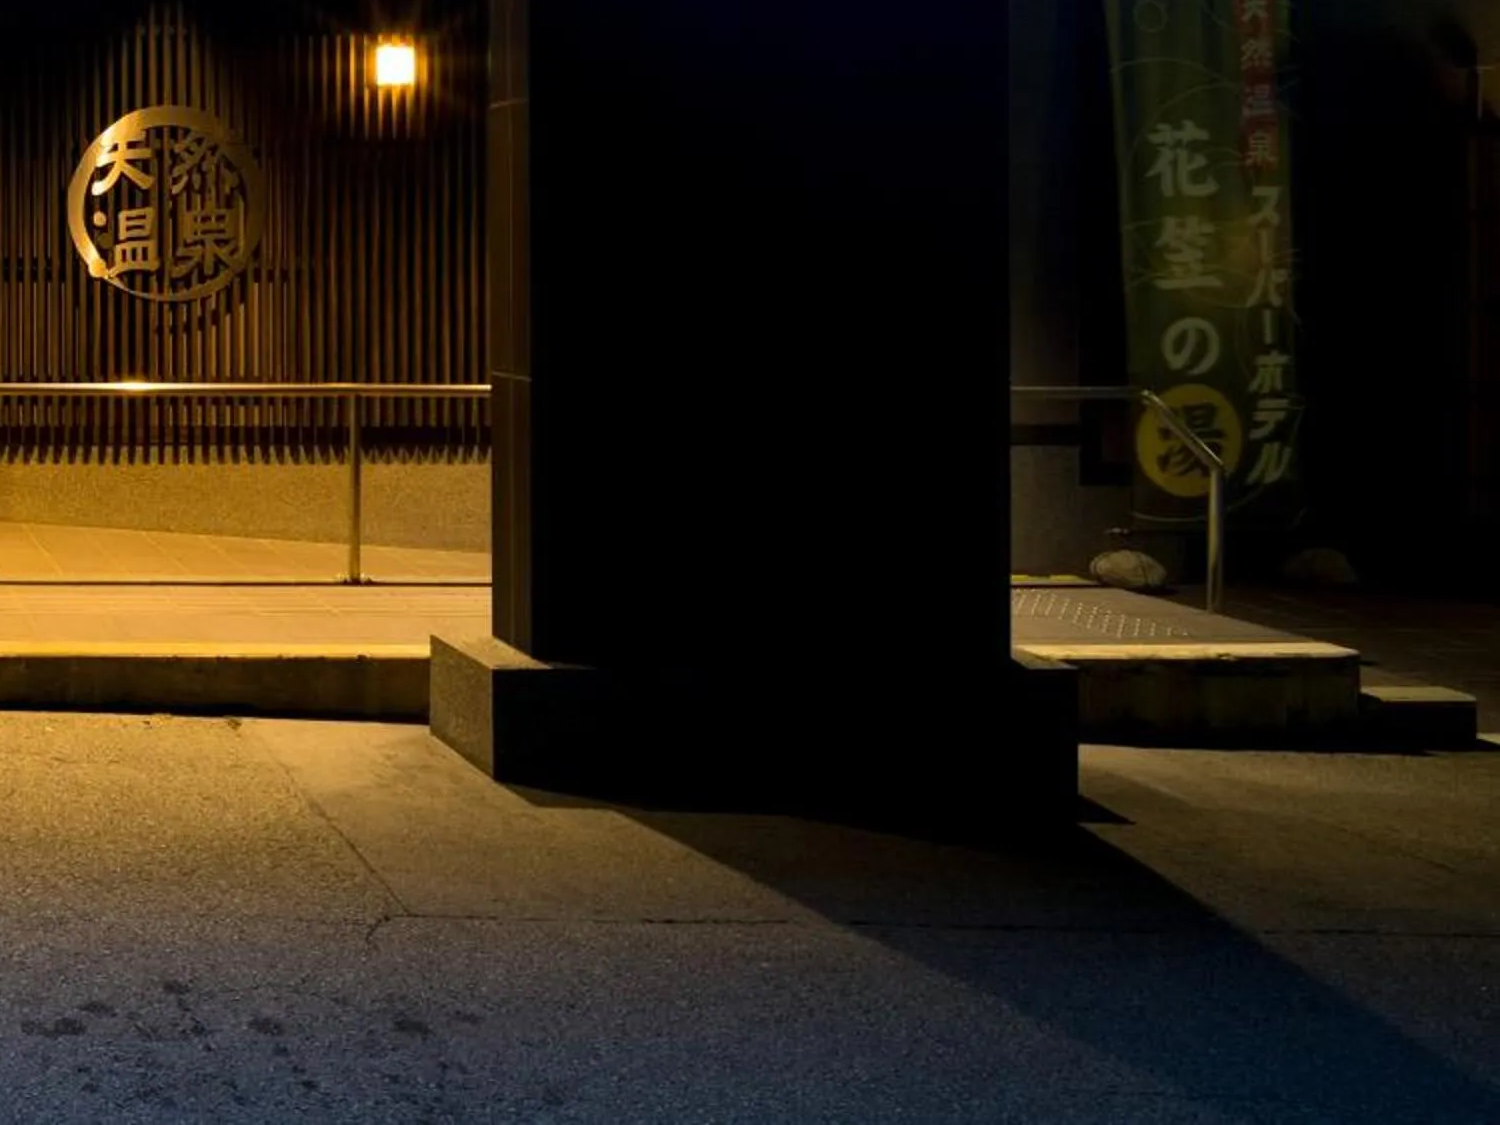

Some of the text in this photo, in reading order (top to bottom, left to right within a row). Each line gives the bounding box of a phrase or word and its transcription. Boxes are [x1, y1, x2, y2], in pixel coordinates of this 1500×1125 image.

[1244, 183, 1294, 486] スーパーホテル
